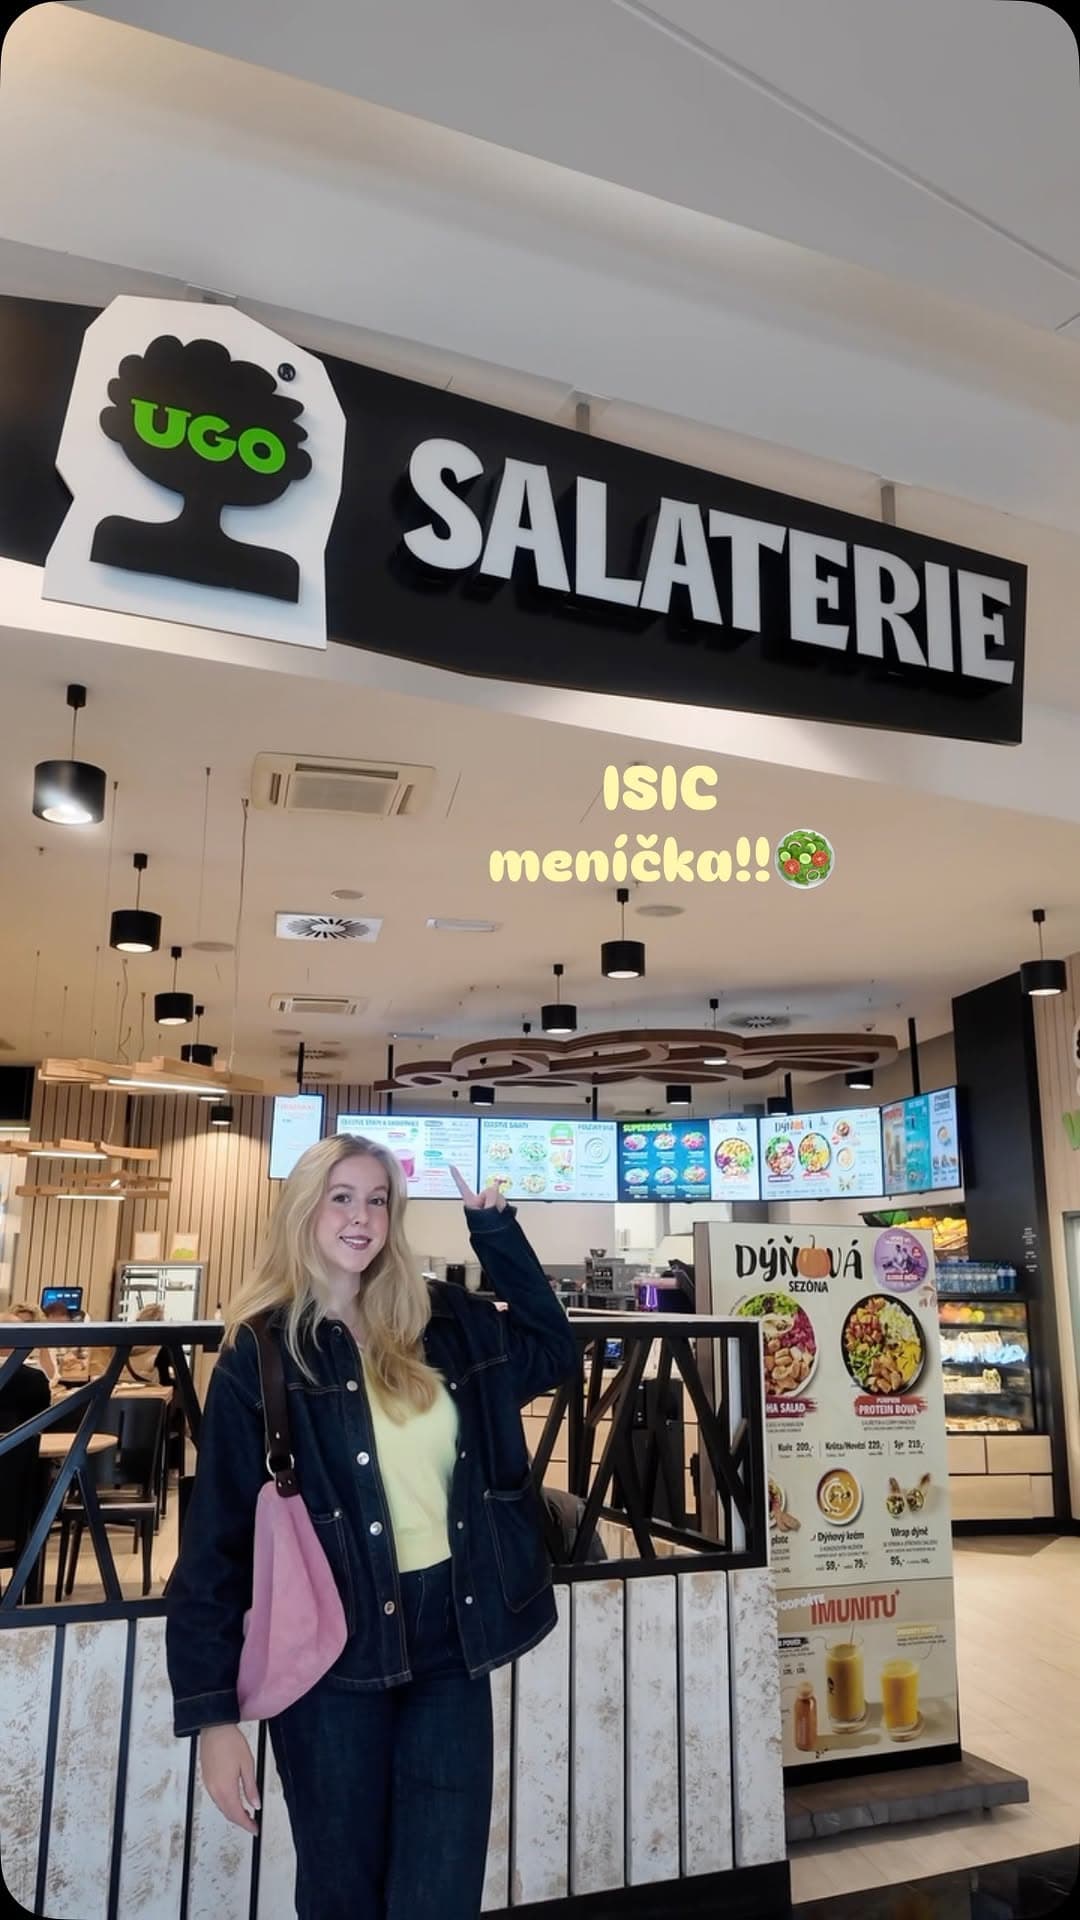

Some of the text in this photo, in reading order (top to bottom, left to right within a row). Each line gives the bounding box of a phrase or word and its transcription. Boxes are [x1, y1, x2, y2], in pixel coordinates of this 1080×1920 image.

[131, 399, 286, 474] UGO
[403, 438, 1015, 685] SALATERIE
[623, 1122, 673, 1133] SUPERBOWLS
[779, 1402, 806, 1414] SALAD
[858, 1403, 919, 1416] PROTEIN BOWL
[890, 1527, 911, 1539] Wrap
